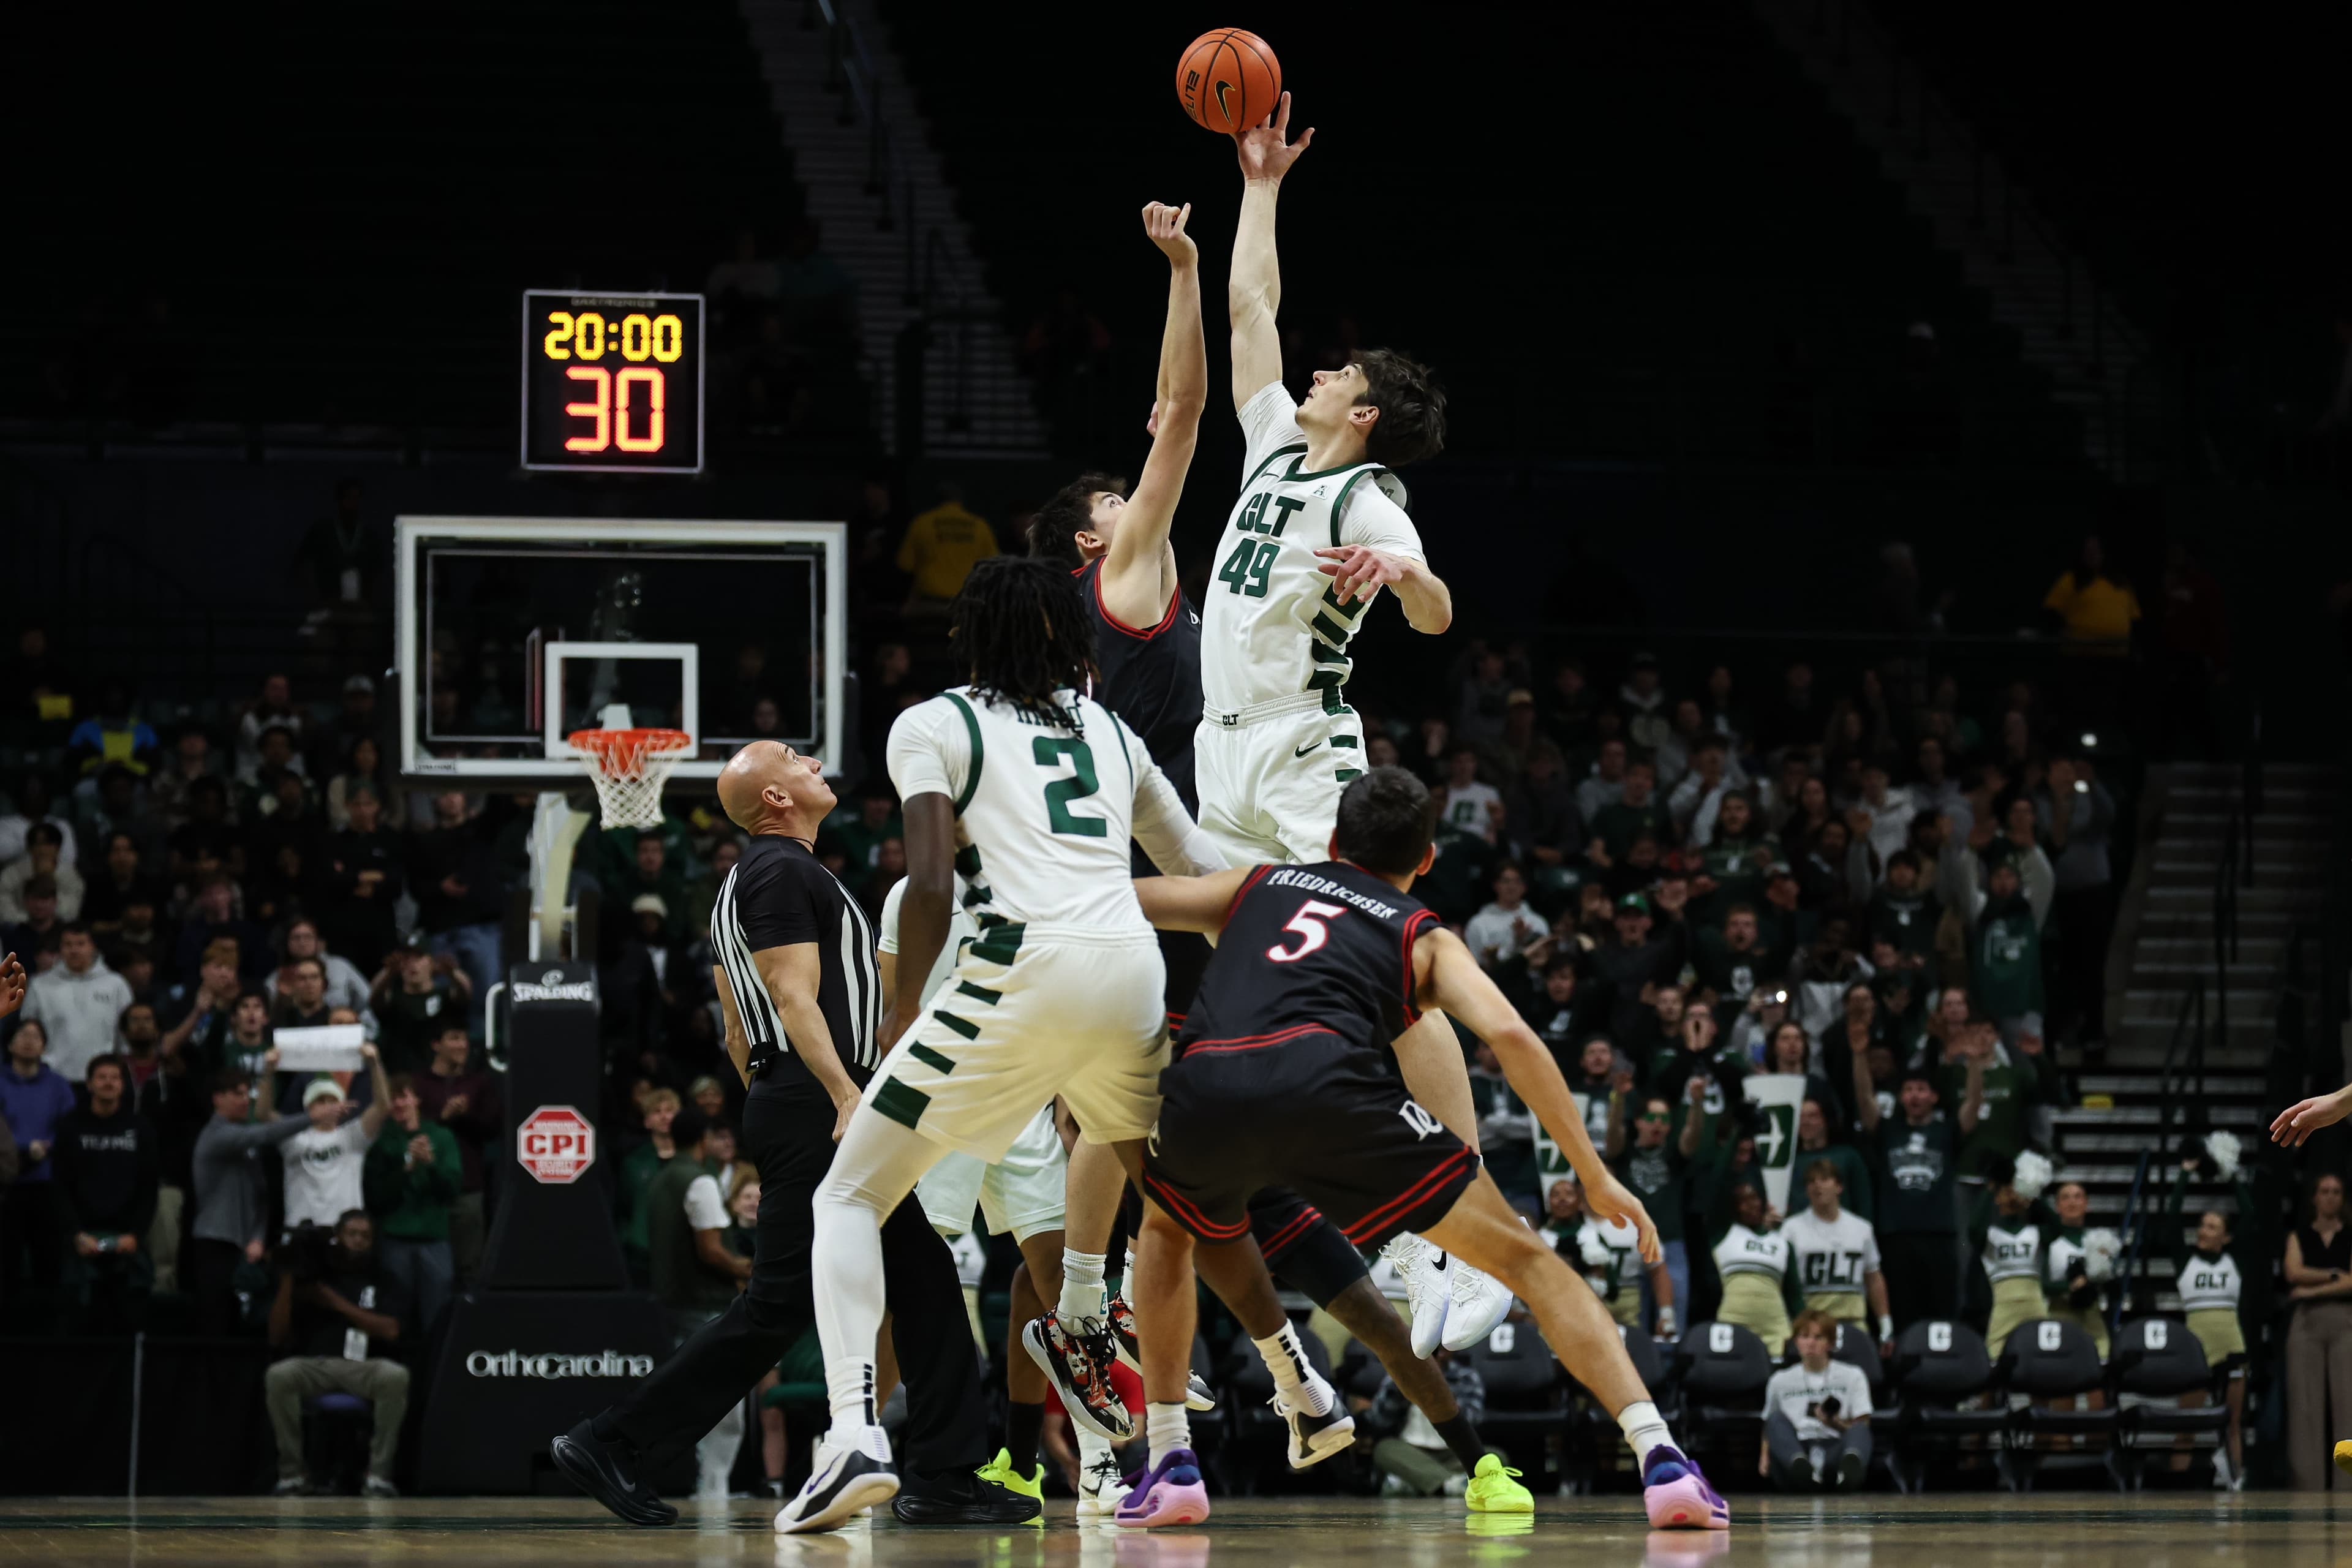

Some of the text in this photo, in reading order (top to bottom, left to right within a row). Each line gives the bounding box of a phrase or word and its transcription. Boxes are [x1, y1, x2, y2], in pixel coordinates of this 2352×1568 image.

[544, 311, 682, 363] 20:00
[564, 366, 665, 452] 30
[1236, 492, 1306, 538] CLT
[1218, 538, 1281, 598] 49
[1223, 714, 1238, 726] CLT
[1032, 736, 1107, 837] 2
[1267, 869, 1399, 919] FRIEDRICHSEN
[1265, 897, 1349, 963] 5
[513, 981, 594, 1002] SPALDING
[527, 1134, 586, 1154] CPI
[1806, 1252, 1863, 1285] CLT
[466, 1349, 655, 1380] OrthoCarolina
